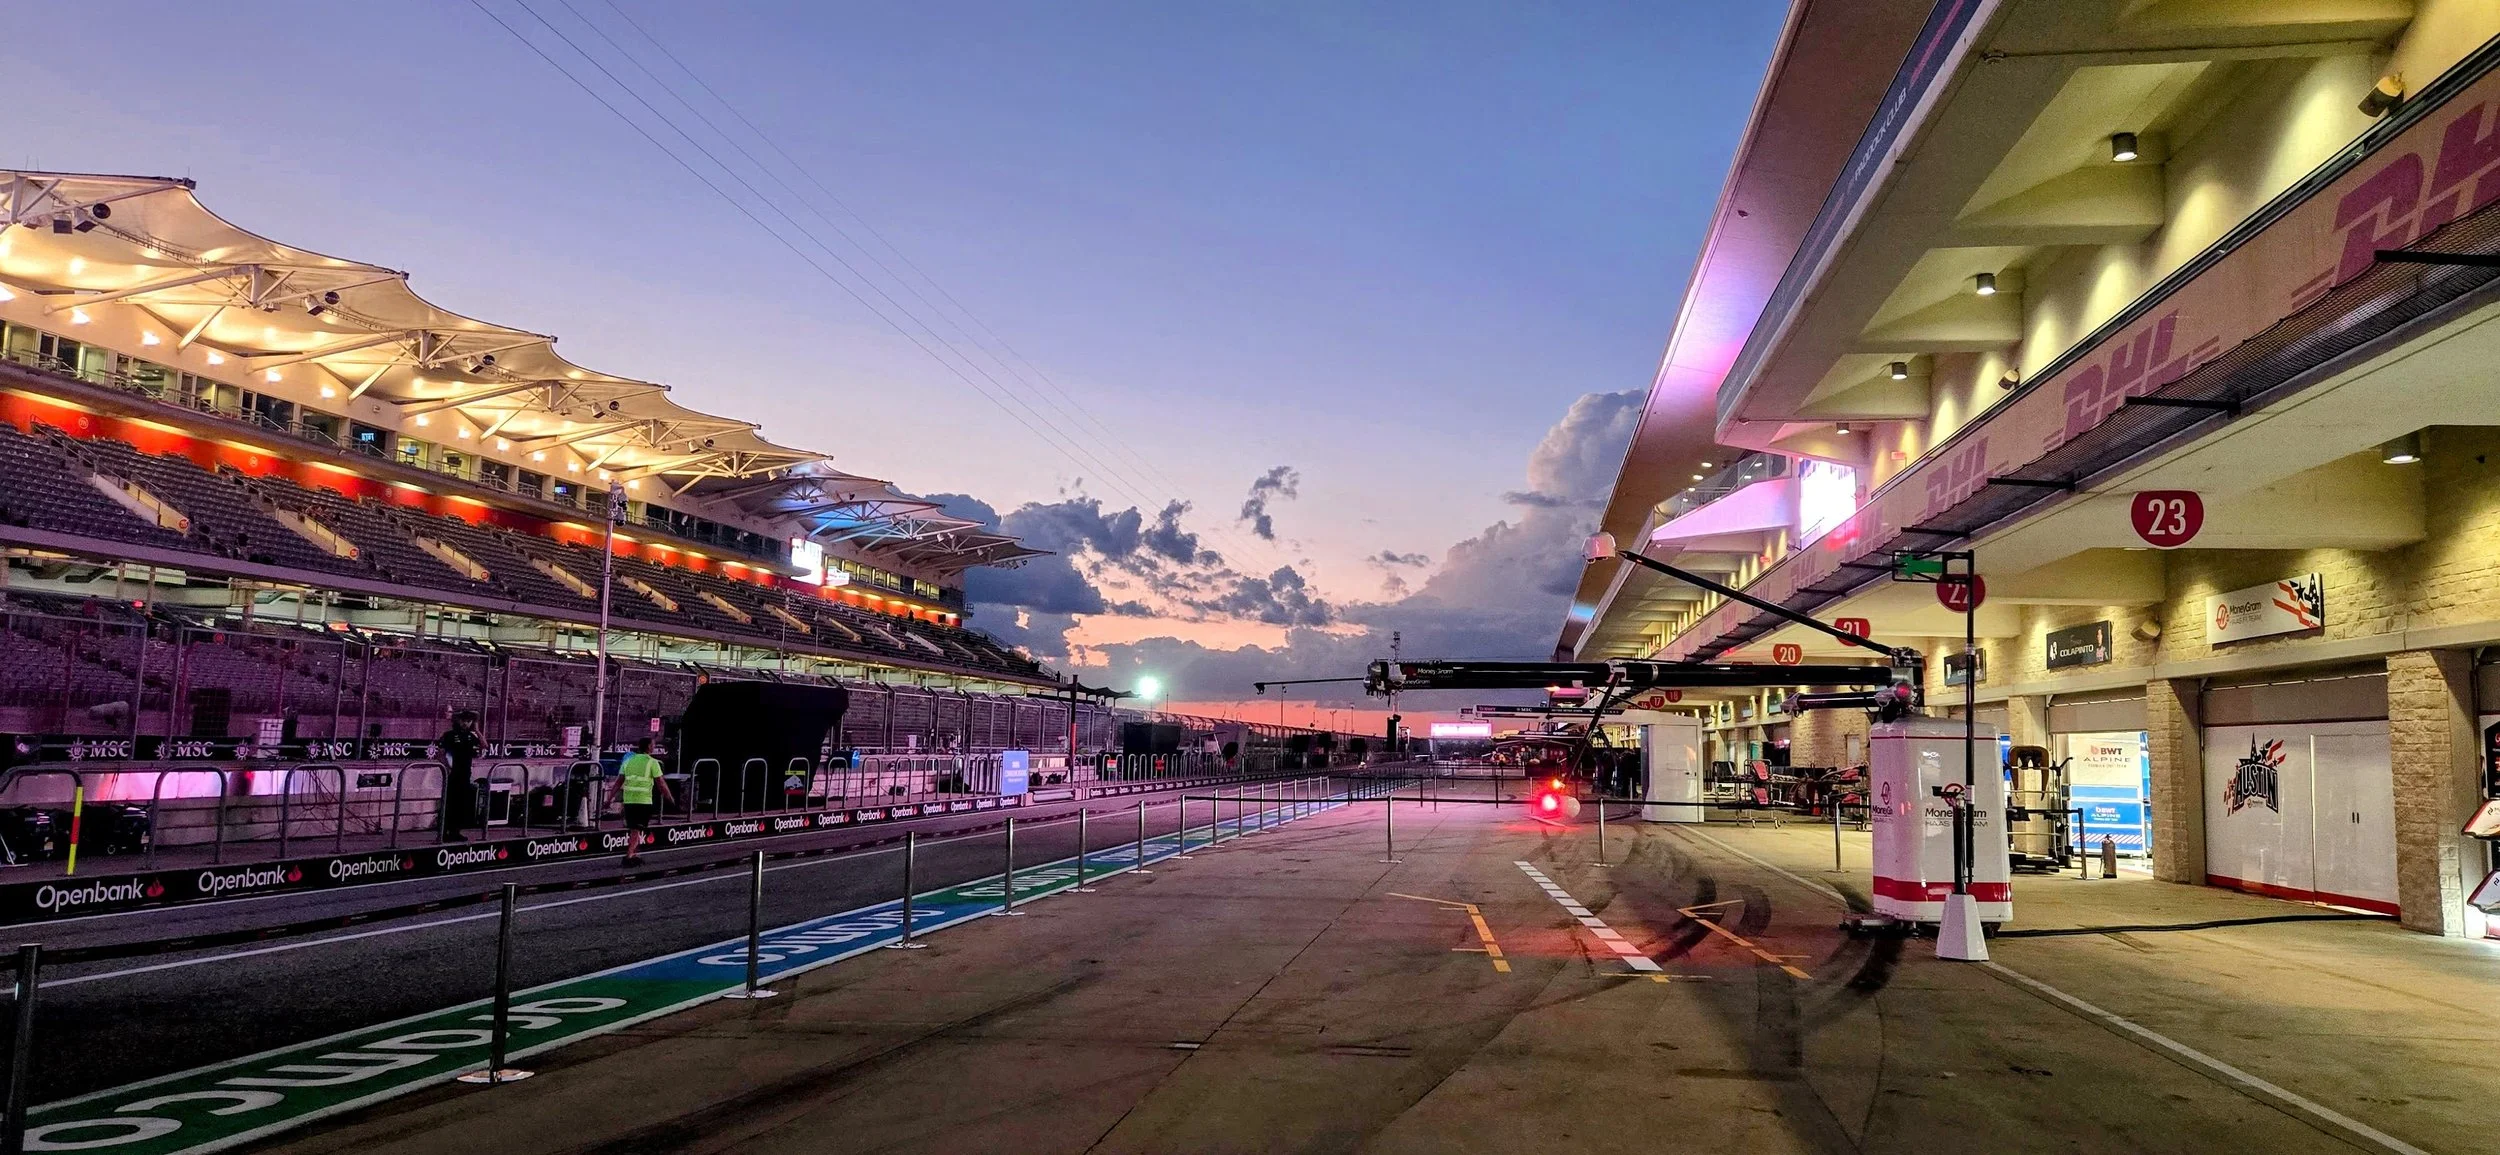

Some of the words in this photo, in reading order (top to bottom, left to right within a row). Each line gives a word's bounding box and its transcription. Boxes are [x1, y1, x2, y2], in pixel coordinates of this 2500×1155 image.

[1886, 87, 1907, 128] CLUB
[2064, 308, 2193, 443] DHL
[1926, 435, 1991, 515] DHL
[2146, 497, 2187, 537] 23
[2229, 601, 2262, 614] MoneyGram
[1843, 621, 1860, 637] 21
[1779, 647, 1796, 663] 20
[2059, 644, 2094, 657] COLAPINTO
[1654, 695, 1661, 703] 17
[90, 740, 130, 757] MSC
[176, 741, 214, 757] MSC
[383, 742, 410, 756] MSC
[489, 743, 511, 756] MC
[2232, 763, 2279, 814] AUSTIN
[818, 812, 844, 828] Openbank
[857, 809, 880, 823] Openbank
[1925, 808, 1987, 818] Moneam
[725, 820, 759, 837] Openbank
[774, 816, 804, 832] Openbank
[668, 825, 706, 844] Openbank
[437, 845, 497, 870] Openbank
[527, 838, 578, 860] Openbank
[329, 855, 400, 881] Openbank
[198, 865, 286, 895] Openbank
[36, 878, 144, 912] Openbank
